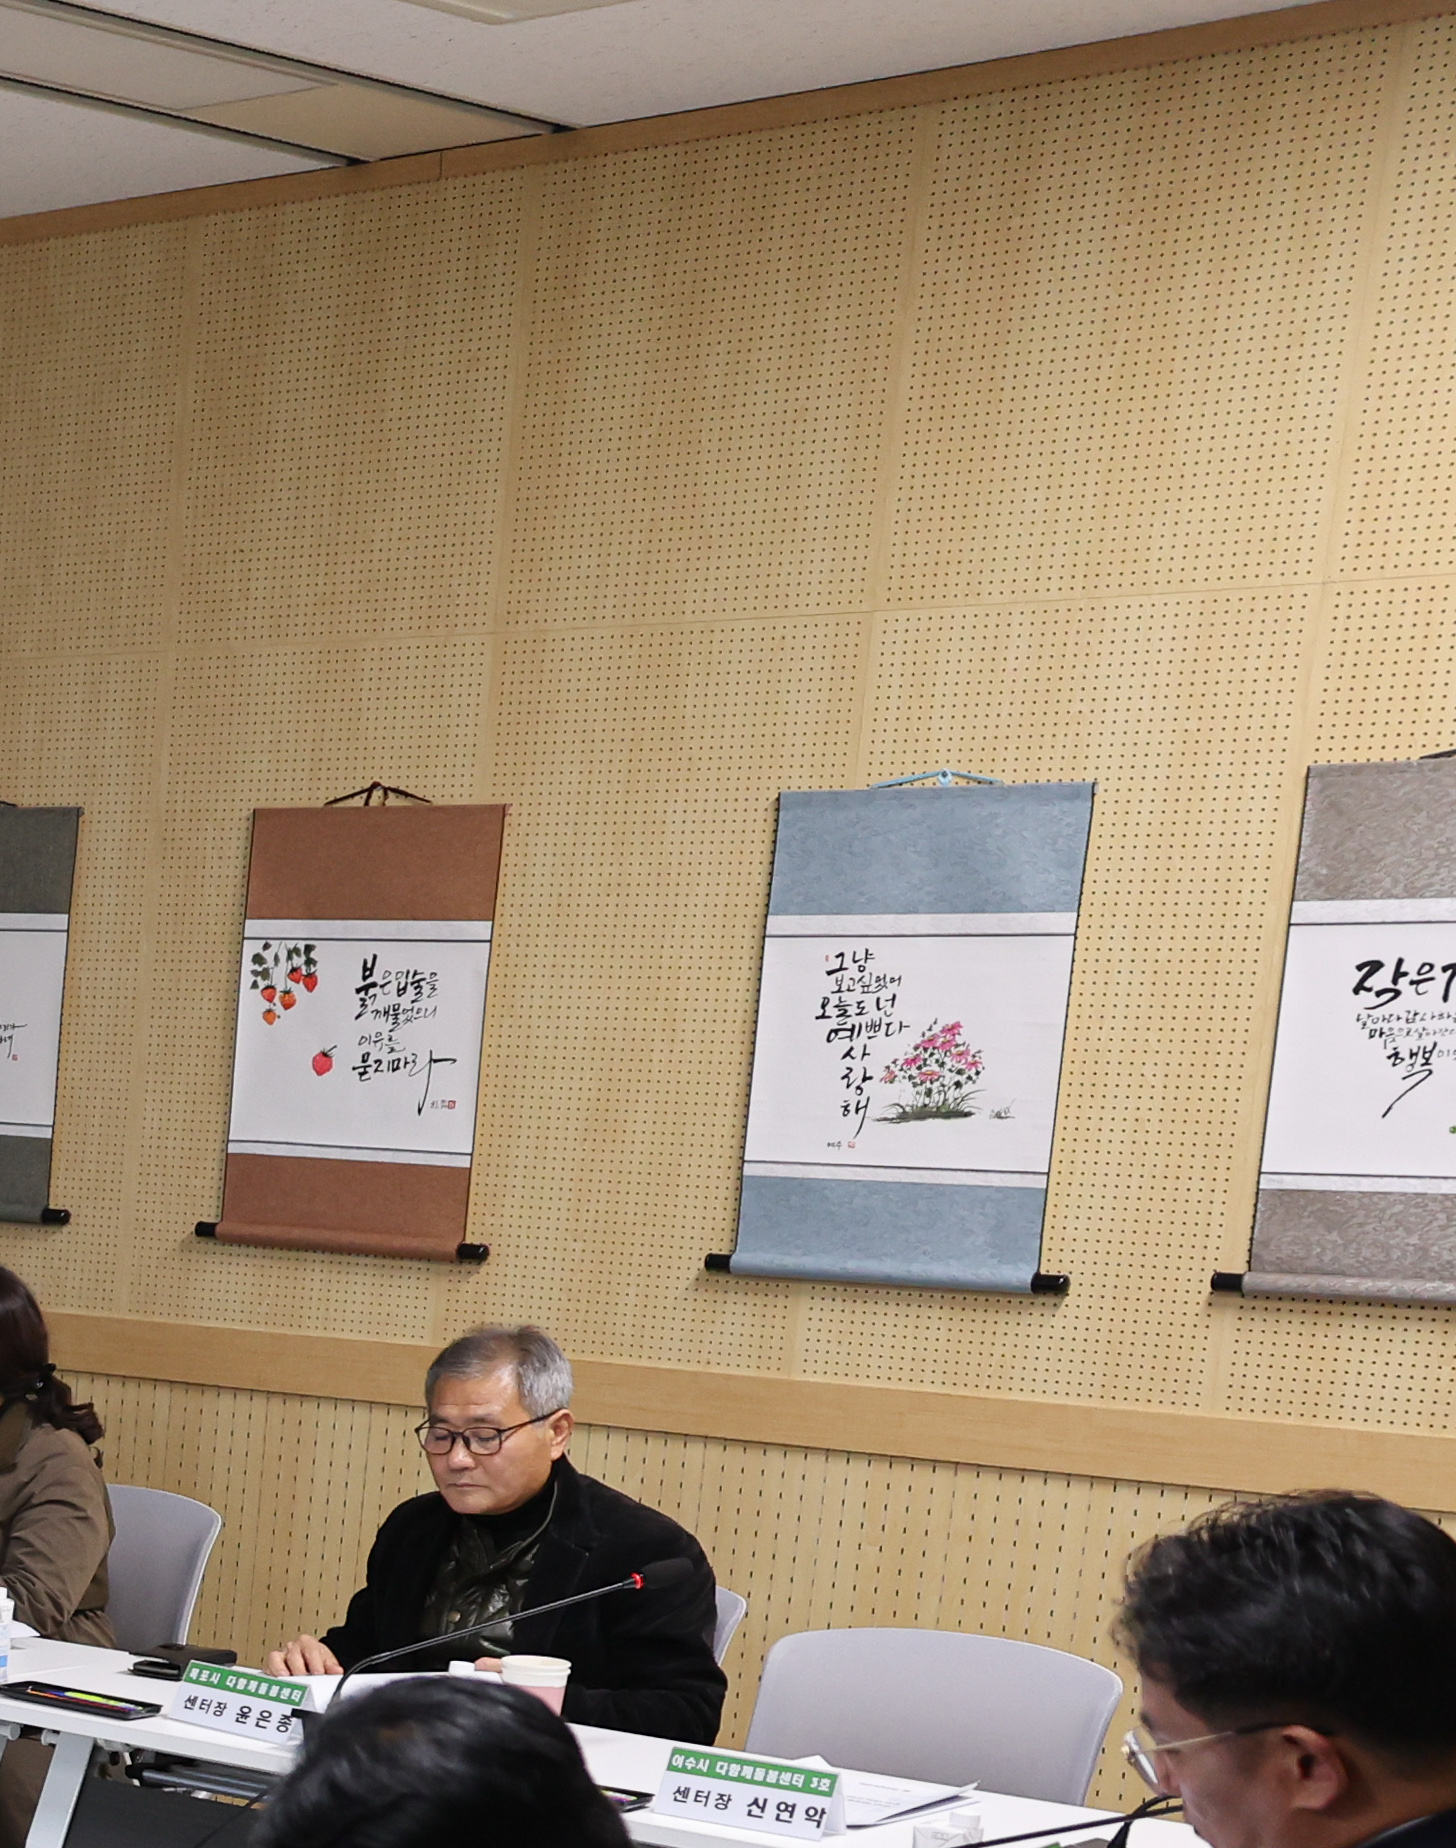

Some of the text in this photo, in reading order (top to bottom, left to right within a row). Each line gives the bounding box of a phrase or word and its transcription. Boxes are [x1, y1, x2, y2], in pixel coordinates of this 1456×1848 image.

[825, 947, 876, 977] 그냥
[354, 953, 392, 1021] 붉은
[1352, 956, 1437, 1011] 작은
[372, 1002, 438, 1033] 깨물었으니
[814, 993, 899, 1021] 오늘도 넌
[358, 1031, 406, 1053] 이유를
[825, 1016, 912, 1044] 예쁘다
[188, 1666, 304, 1704] 목포시 다함께돌봄센터
[183, 1693, 229, 1719] 센터장
[671, 1752, 710, 1774] 여수시
[715, 1758, 807, 1790] 다함께돌봄센터
[671, 1784, 828, 1830] 센터장 신연악
